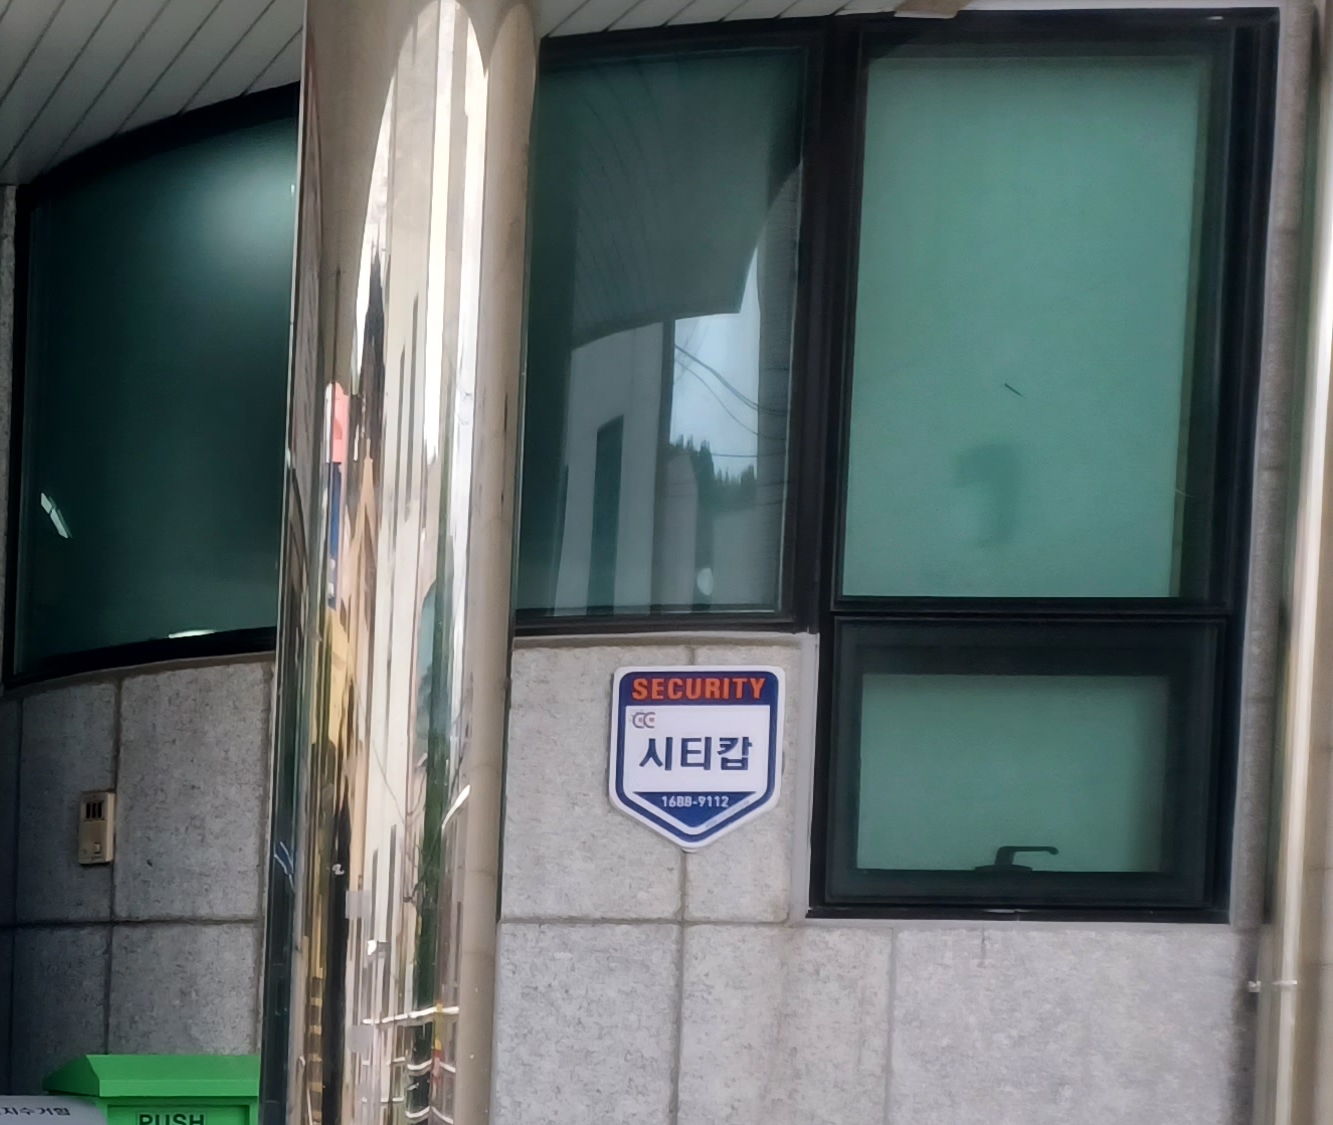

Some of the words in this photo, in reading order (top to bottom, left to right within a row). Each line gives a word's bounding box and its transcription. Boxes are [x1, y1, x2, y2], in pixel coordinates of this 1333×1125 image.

[631, 677, 767, 701] SECURITY
[638, 736, 753, 771] 시티캅
[661, 795, 730, 808] 1688-9112
